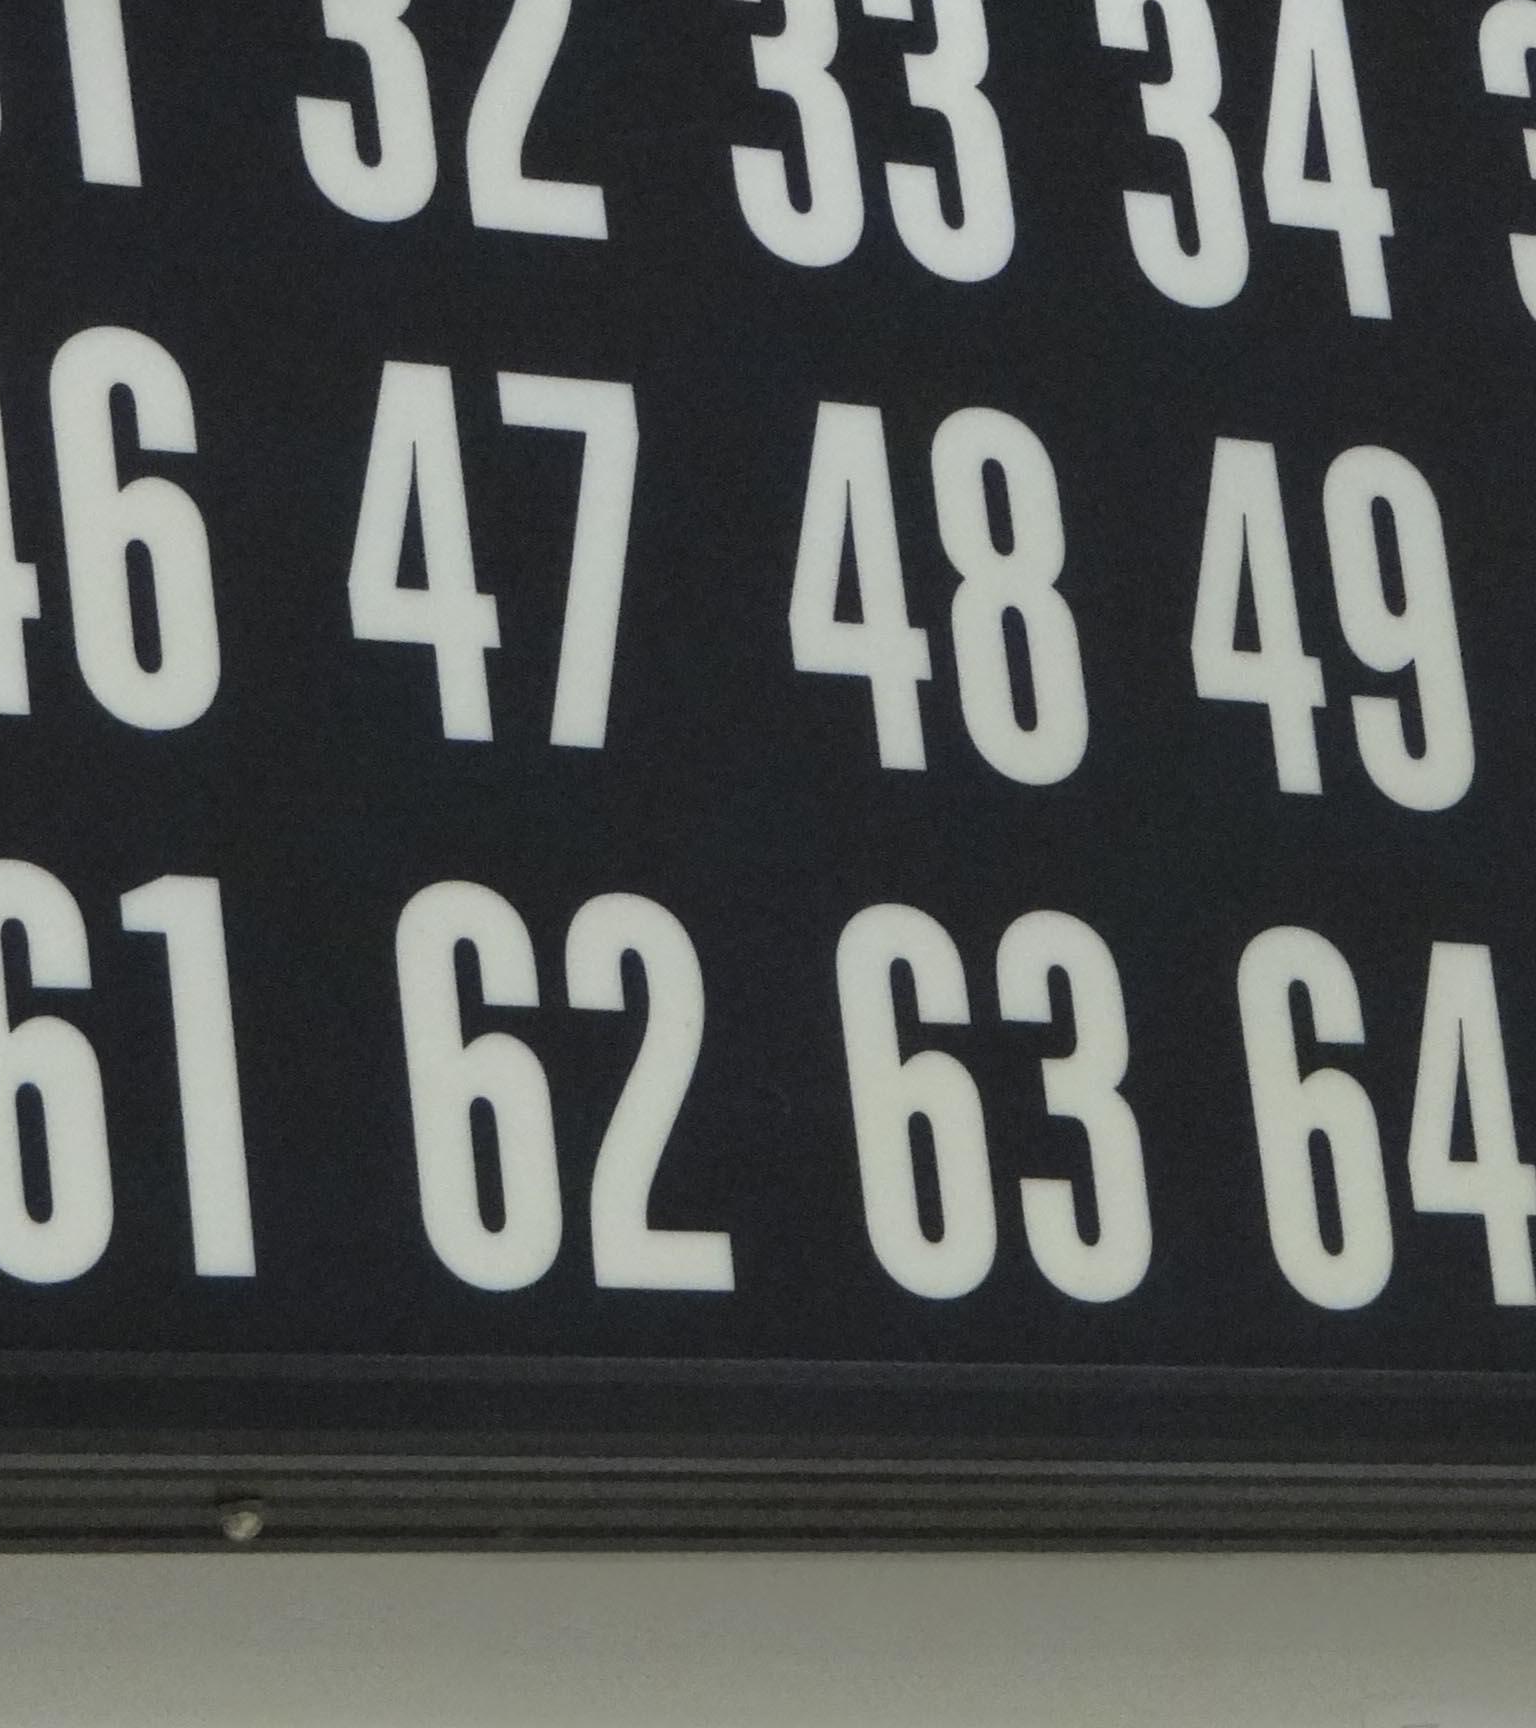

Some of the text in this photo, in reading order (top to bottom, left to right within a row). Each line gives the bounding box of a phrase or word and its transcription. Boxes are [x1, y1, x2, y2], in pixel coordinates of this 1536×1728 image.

[347, 361, 639, 748] 47
[788, 401, 1089, 785] 48
[1191, 437, 1475, 811] 49
[395, 880, 735, 1291] 62
[836, 903, 1152, 1303] 63
